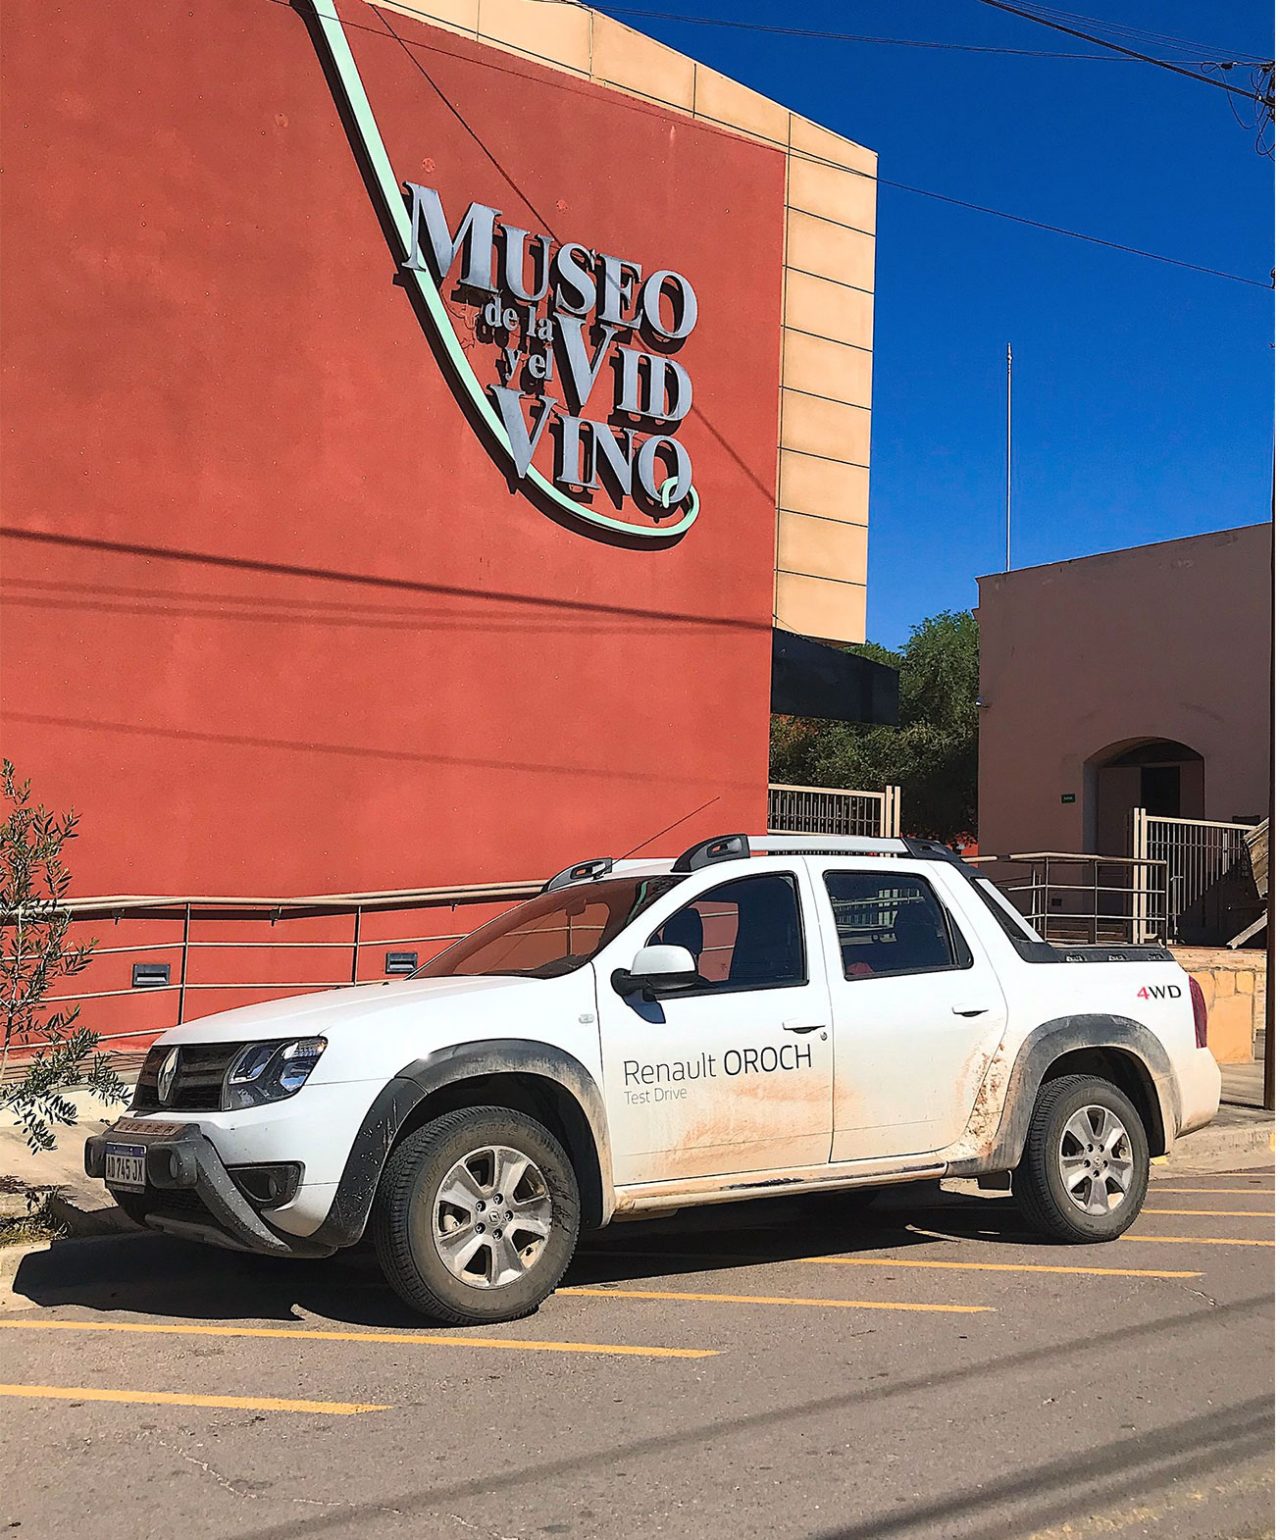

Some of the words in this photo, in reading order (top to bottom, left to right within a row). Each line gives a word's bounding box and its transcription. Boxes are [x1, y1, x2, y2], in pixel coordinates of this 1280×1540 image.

[401, 180, 698, 340] MUSEO
[484, 297, 520, 332] de
[526, 305, 555, 342] la
[503, 348, 523, 381] y
[528, 346, 553, 382] el
[552, 312, 693, 422] VID
[489, 383, 693, 505] VINO
[1137, 985, 1182, 1000] 4WD
[623, 1052, 717, 1086] Renault
[723, 1043, 812, 1076] OROCH
[624, 1088, 651, 1105] Test
[654, 1086, 688, 1102] Drive
[117, 1157, 131, 1180] 745
